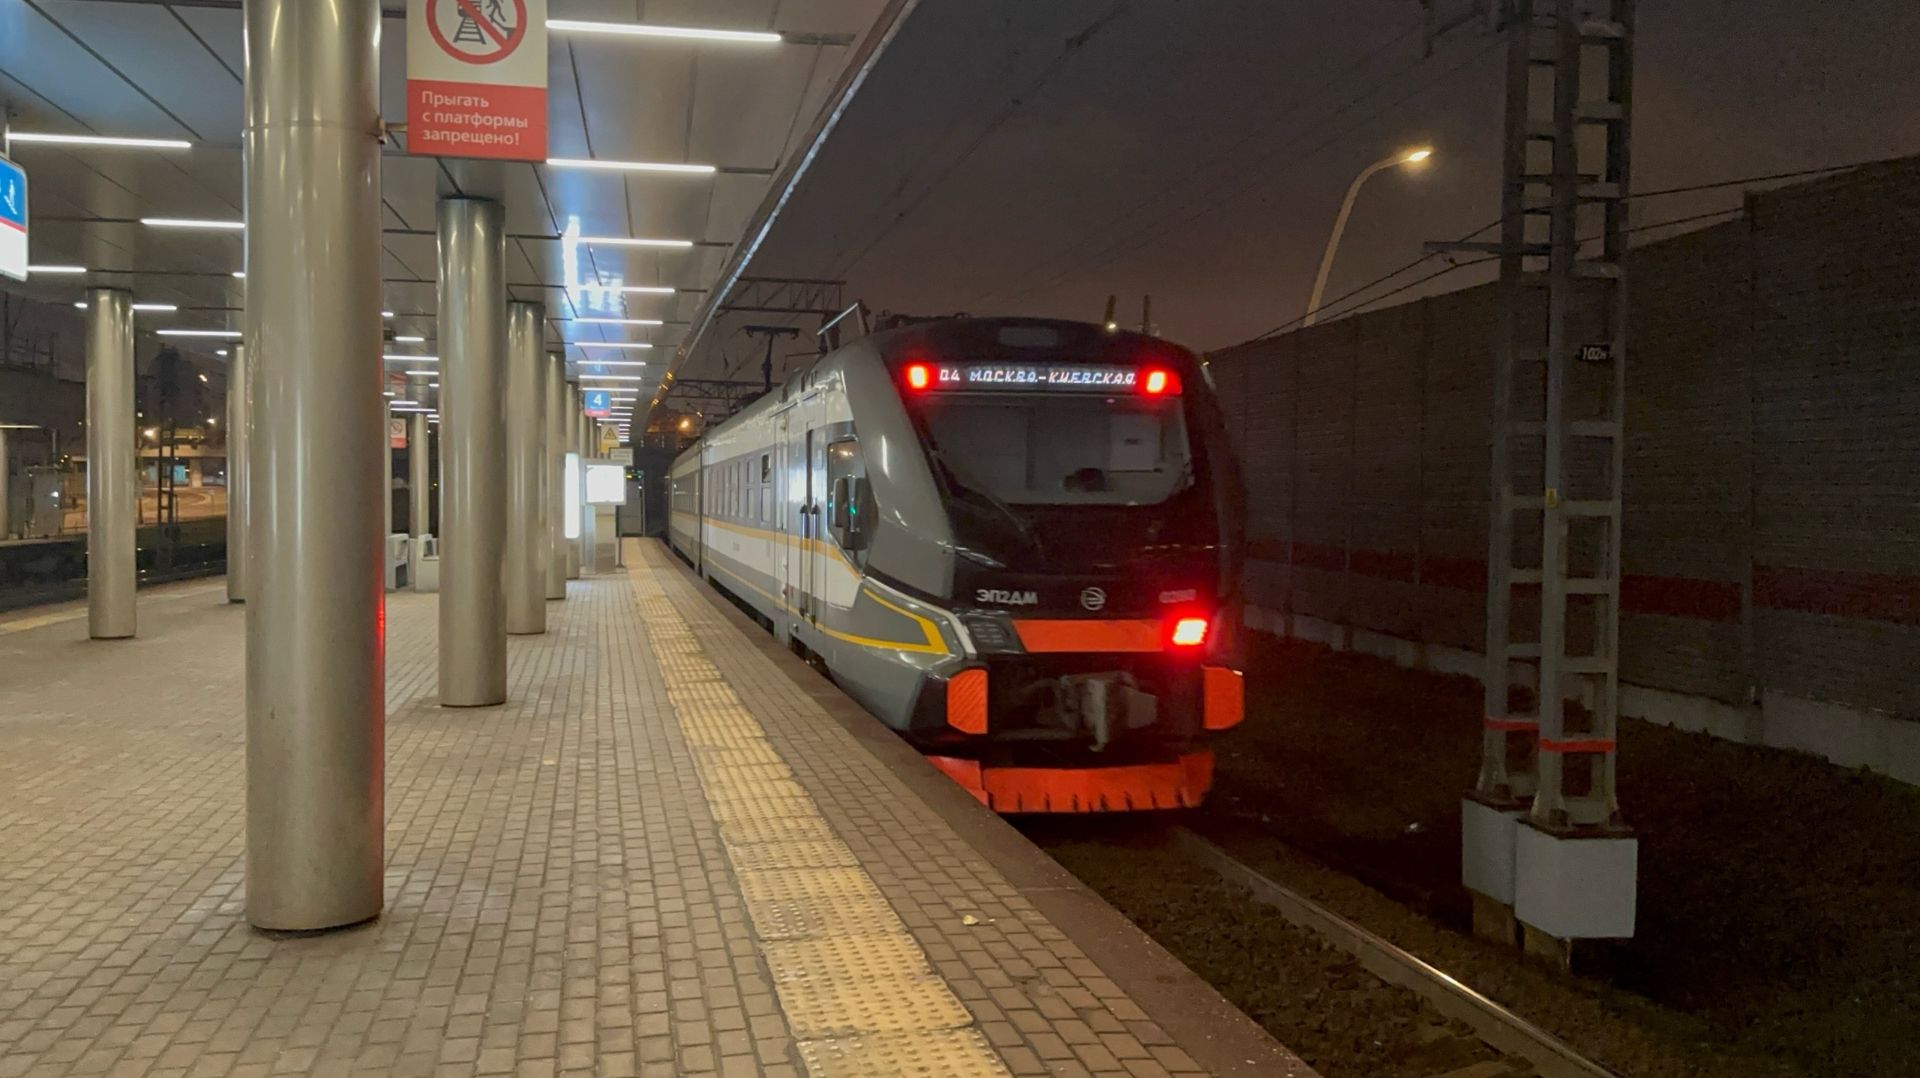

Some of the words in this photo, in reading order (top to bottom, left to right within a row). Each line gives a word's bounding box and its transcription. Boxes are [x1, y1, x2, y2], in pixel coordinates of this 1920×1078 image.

[421, 90, 490, 108] Прыгать
[422, 111, 431, 122] с
[434, 111, 528, 129] платформы
[423, 129, 519, 146] запрещено!
[593, 393, 602, 406] 4
[976, 589, 1038, 606] ЭП2ДМ
